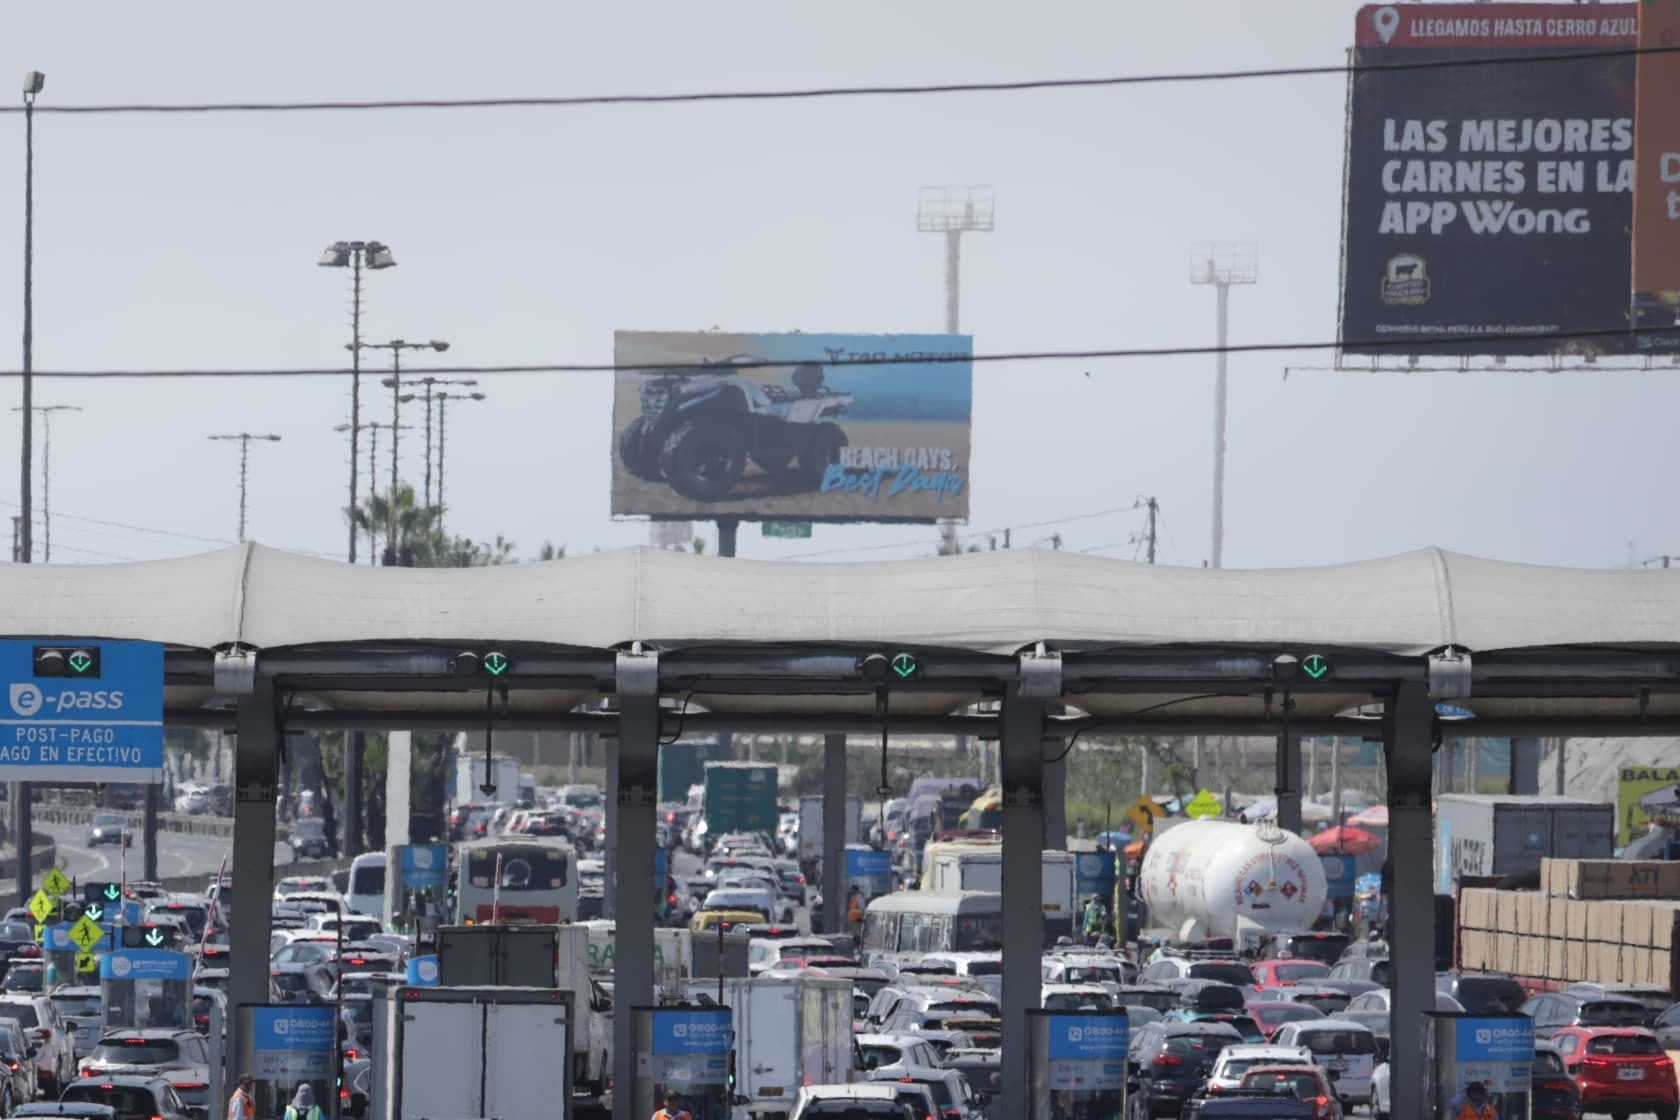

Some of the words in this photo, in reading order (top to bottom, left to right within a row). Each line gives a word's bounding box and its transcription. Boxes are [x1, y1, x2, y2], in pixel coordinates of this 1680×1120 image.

[1411, 19, 1490, 37] LLEGAMOS
[1494, 19, 1542, 36] HASTA
[1546, 19, 1596, 36] CERRO
[1599, 17, 1638, 36] AZUL
[1383, 118, 1448, 151] LAS
[1459, 118, 1633, 152] MEJORES
[1381, 159, 1526, 193] CARNES
[1537, 160, 1584, 193] EN
[1596, 160, 1635, 193] LA
[1378, 200, 1457, 234] APP
[839, 447, 900, 470] BEACH
[16, 727, 114, 744] POST-PAGO
[40, 746, 59, 762] EN
[67, 747, 141, 764] EFECTIVO
